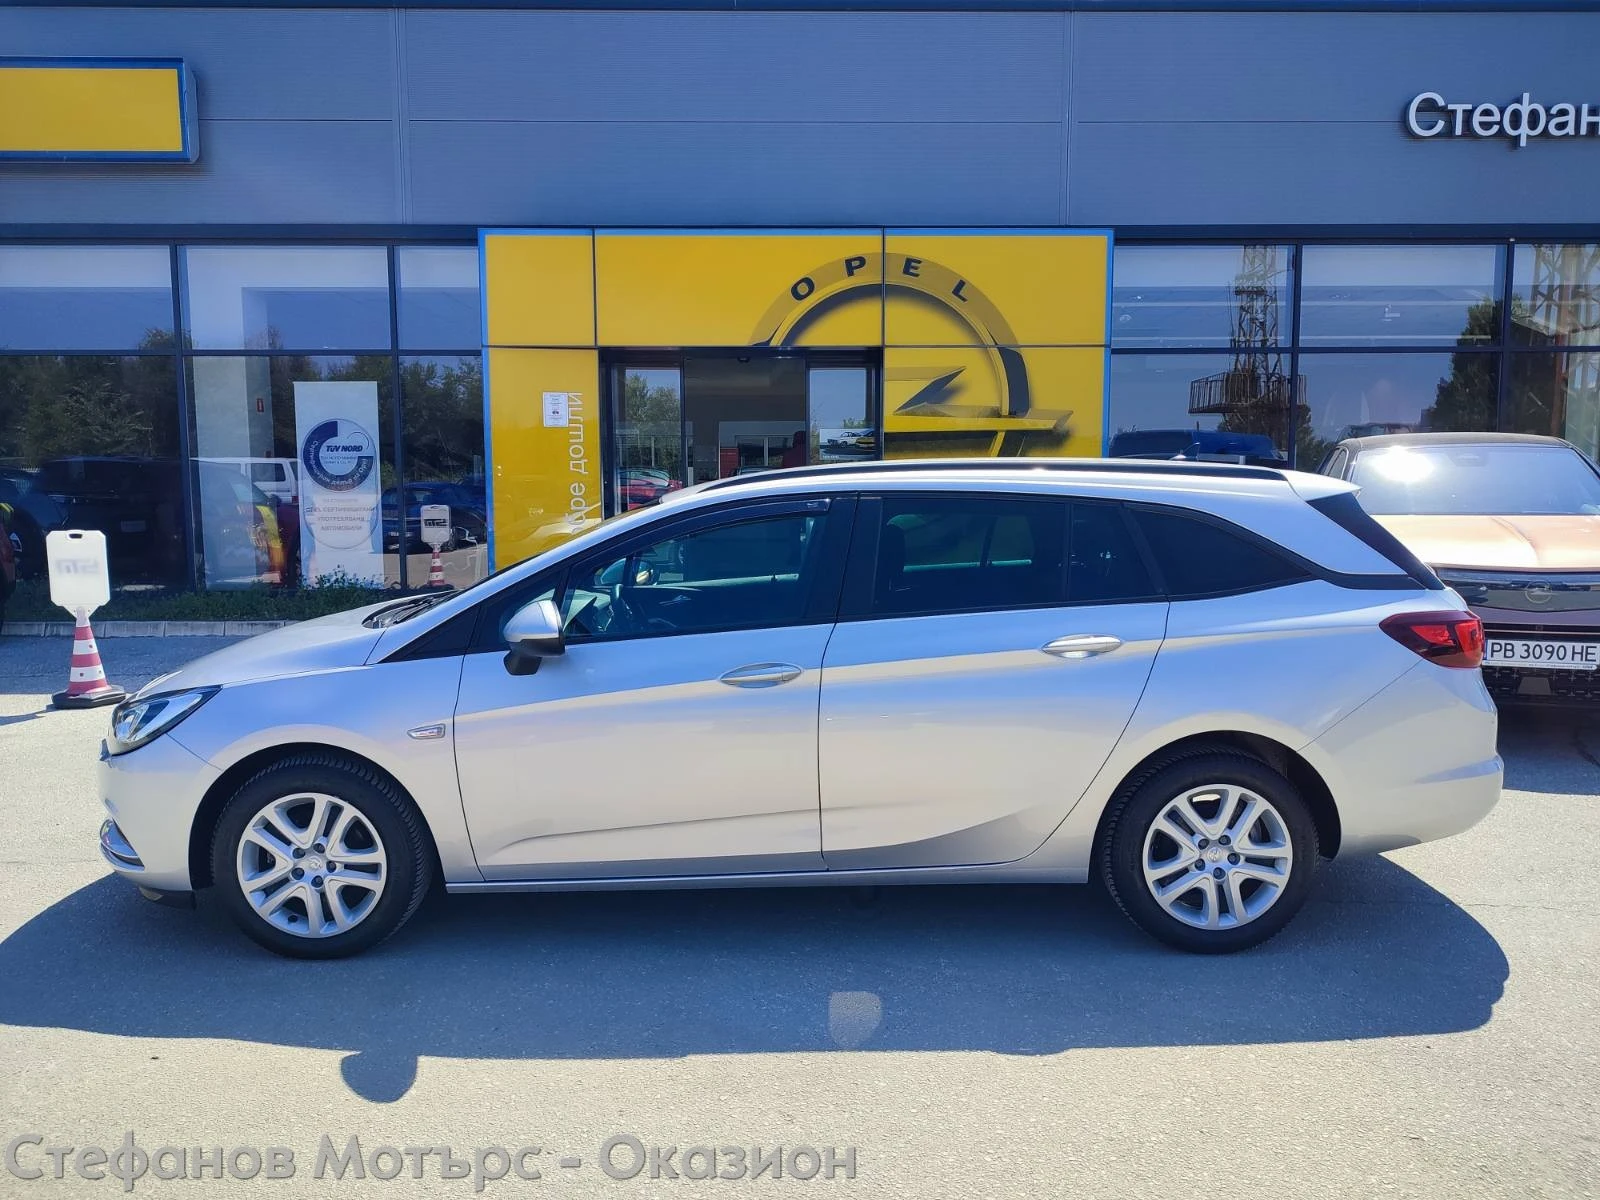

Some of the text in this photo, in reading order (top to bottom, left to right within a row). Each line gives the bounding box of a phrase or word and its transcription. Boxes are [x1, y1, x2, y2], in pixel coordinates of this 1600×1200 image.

[1408, 91, 1600, 147] Стефан
[790, 256, 969, 303] OPEL
[341, 445, 364, 453] NORD
[565, 392, 589, 533] бре дошли
[1490, 642, 1597, 662] PB 3090 HE
